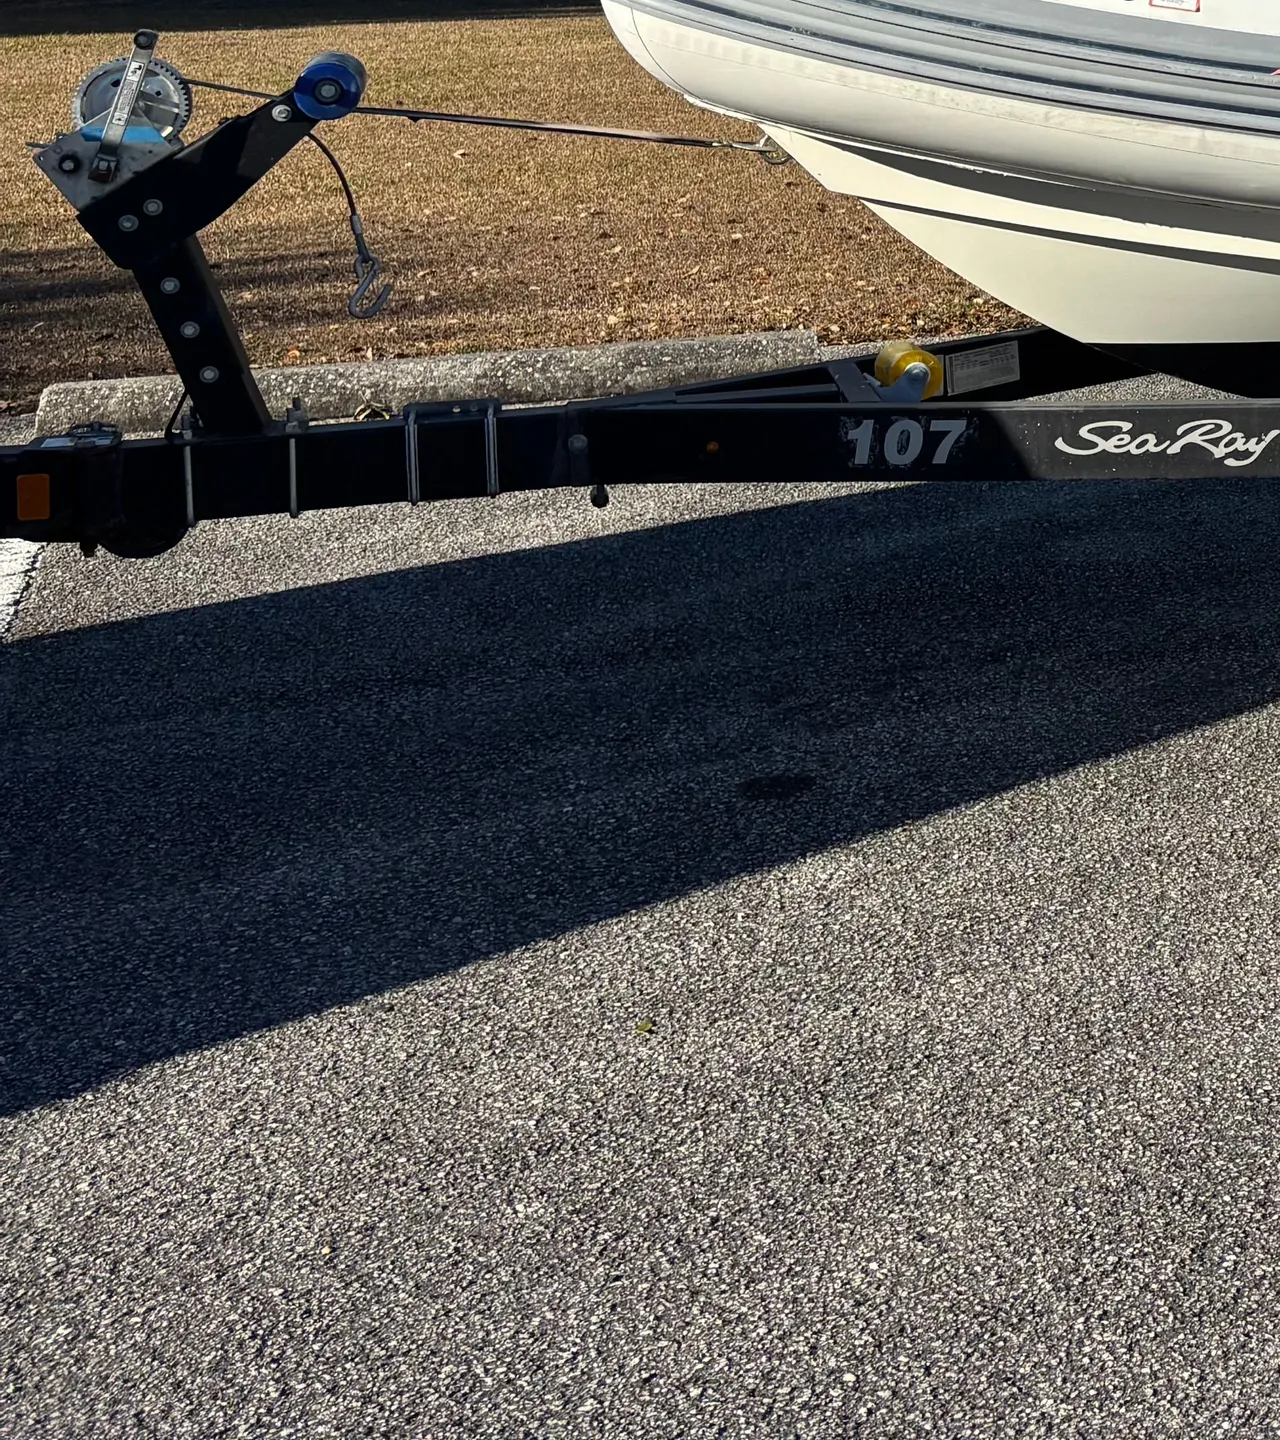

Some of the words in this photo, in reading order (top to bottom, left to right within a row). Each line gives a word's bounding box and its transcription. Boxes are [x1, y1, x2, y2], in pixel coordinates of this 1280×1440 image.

[847, 419, 968, 466] 107
[1054, 420, 1170, 456] Sea
[1166, 419, 1280, 467] Ray
